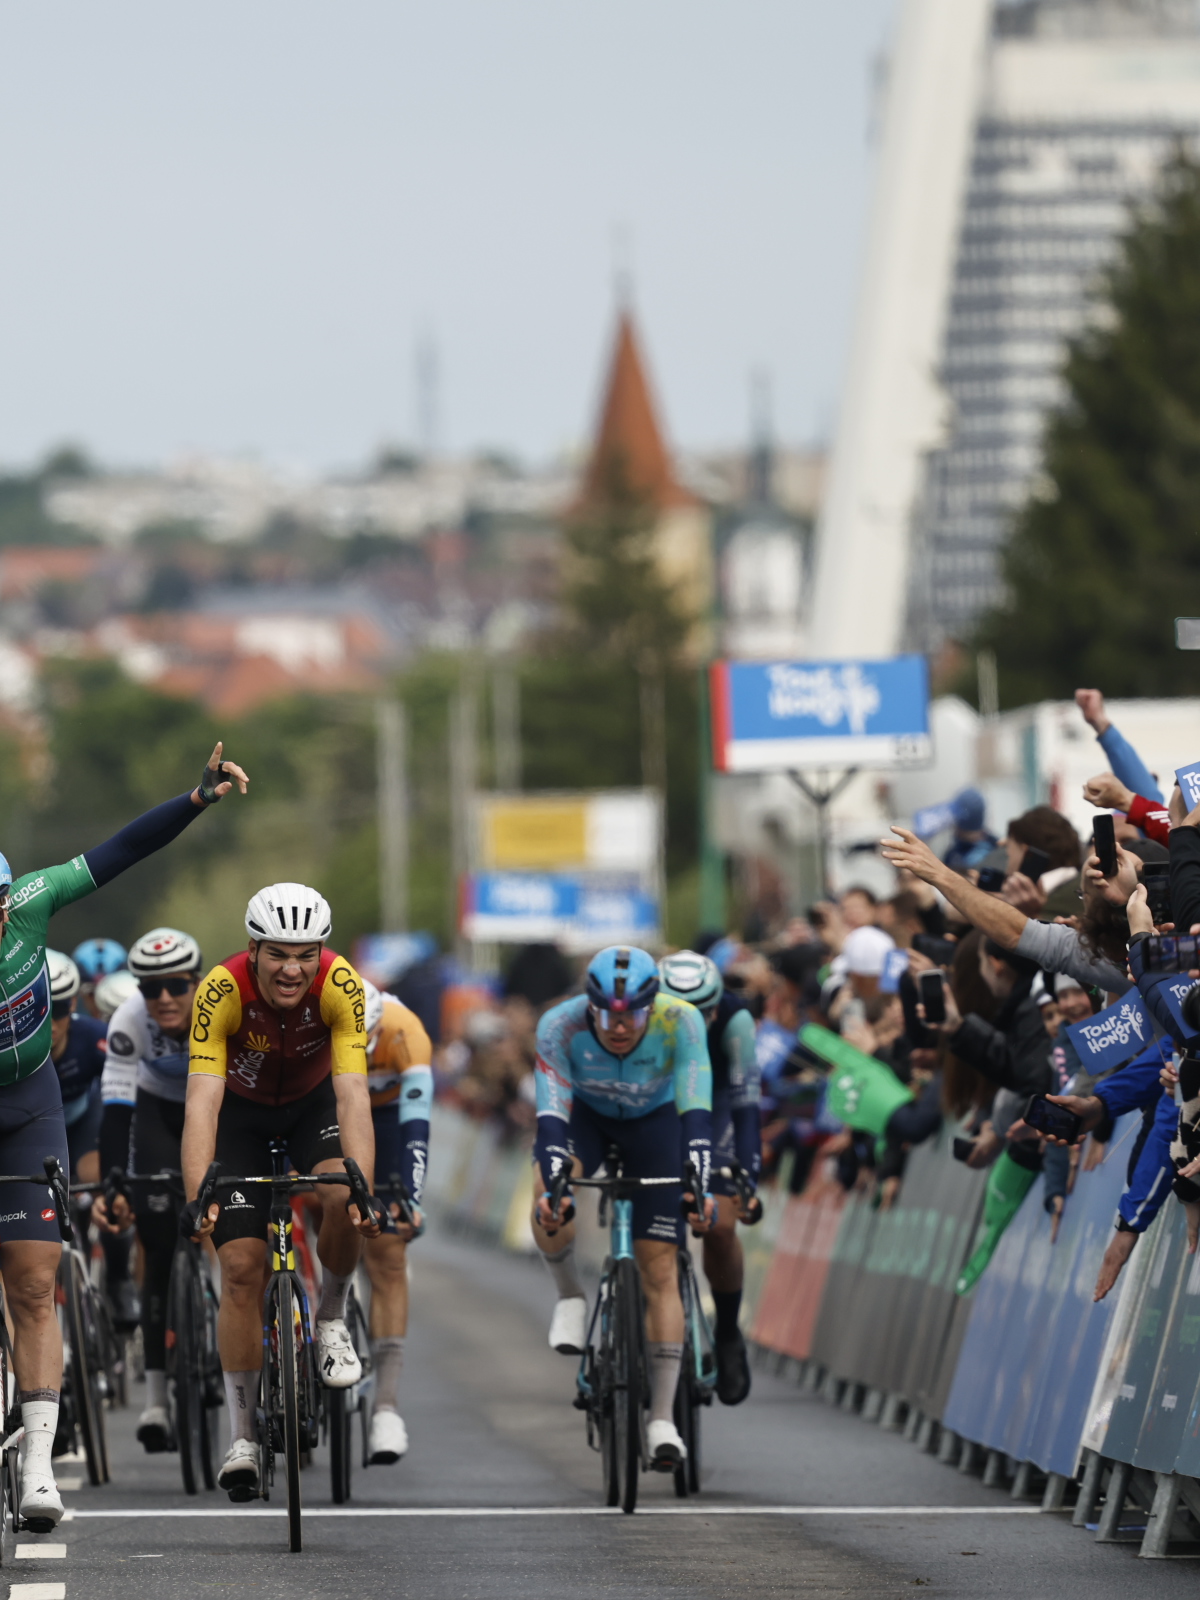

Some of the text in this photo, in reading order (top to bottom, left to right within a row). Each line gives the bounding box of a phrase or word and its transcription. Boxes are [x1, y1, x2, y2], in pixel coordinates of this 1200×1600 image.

[193, 978, 234, 1043] Cofidis
[332, 967, 366, 1033] Cofidis
[1079, 1003, 1131, 1039] Tour de
[228, 1050, 265, 1089] Cofidis
